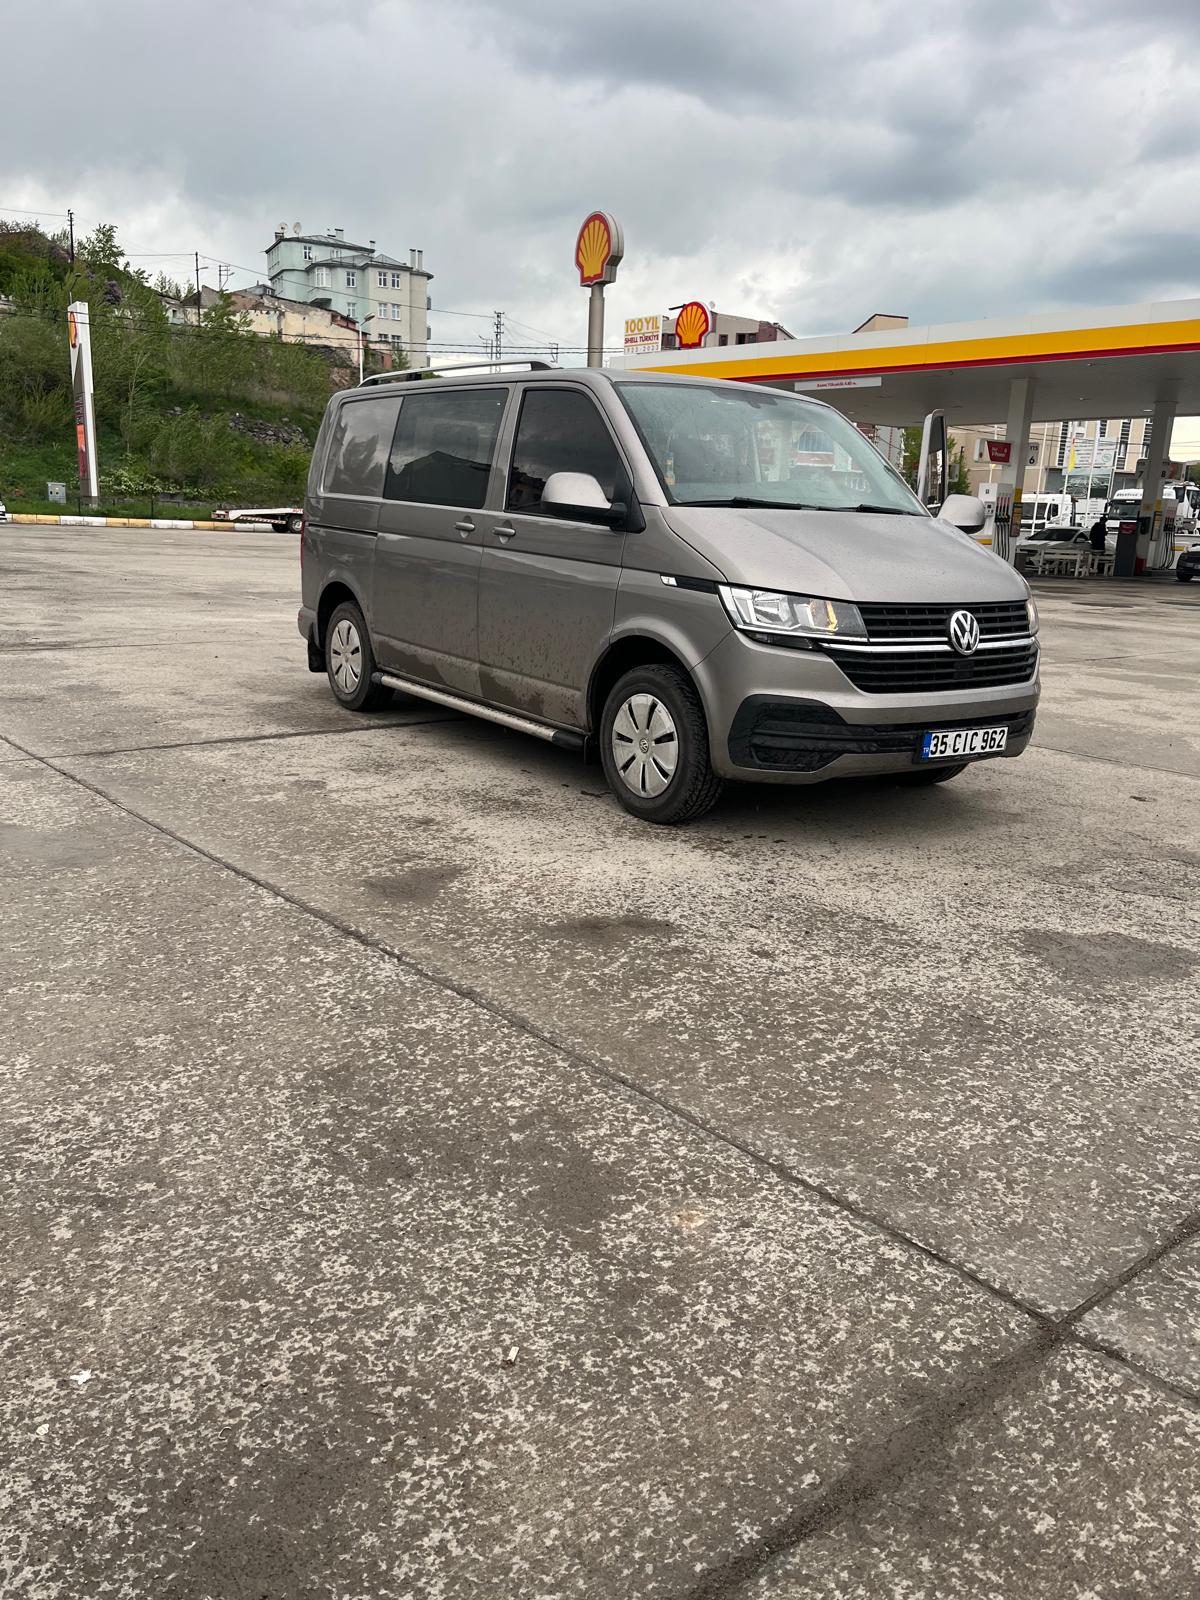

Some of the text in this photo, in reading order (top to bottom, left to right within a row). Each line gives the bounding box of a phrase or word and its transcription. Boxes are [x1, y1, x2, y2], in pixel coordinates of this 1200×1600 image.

[625, 319, 643, 333] 100
[624, 336, 638, 344] SHELL
[1029, 456, 1035, 464] 6
[950, 610, 980, 656] VW
[930, 729, 1006, 755] 35 CIC 962
